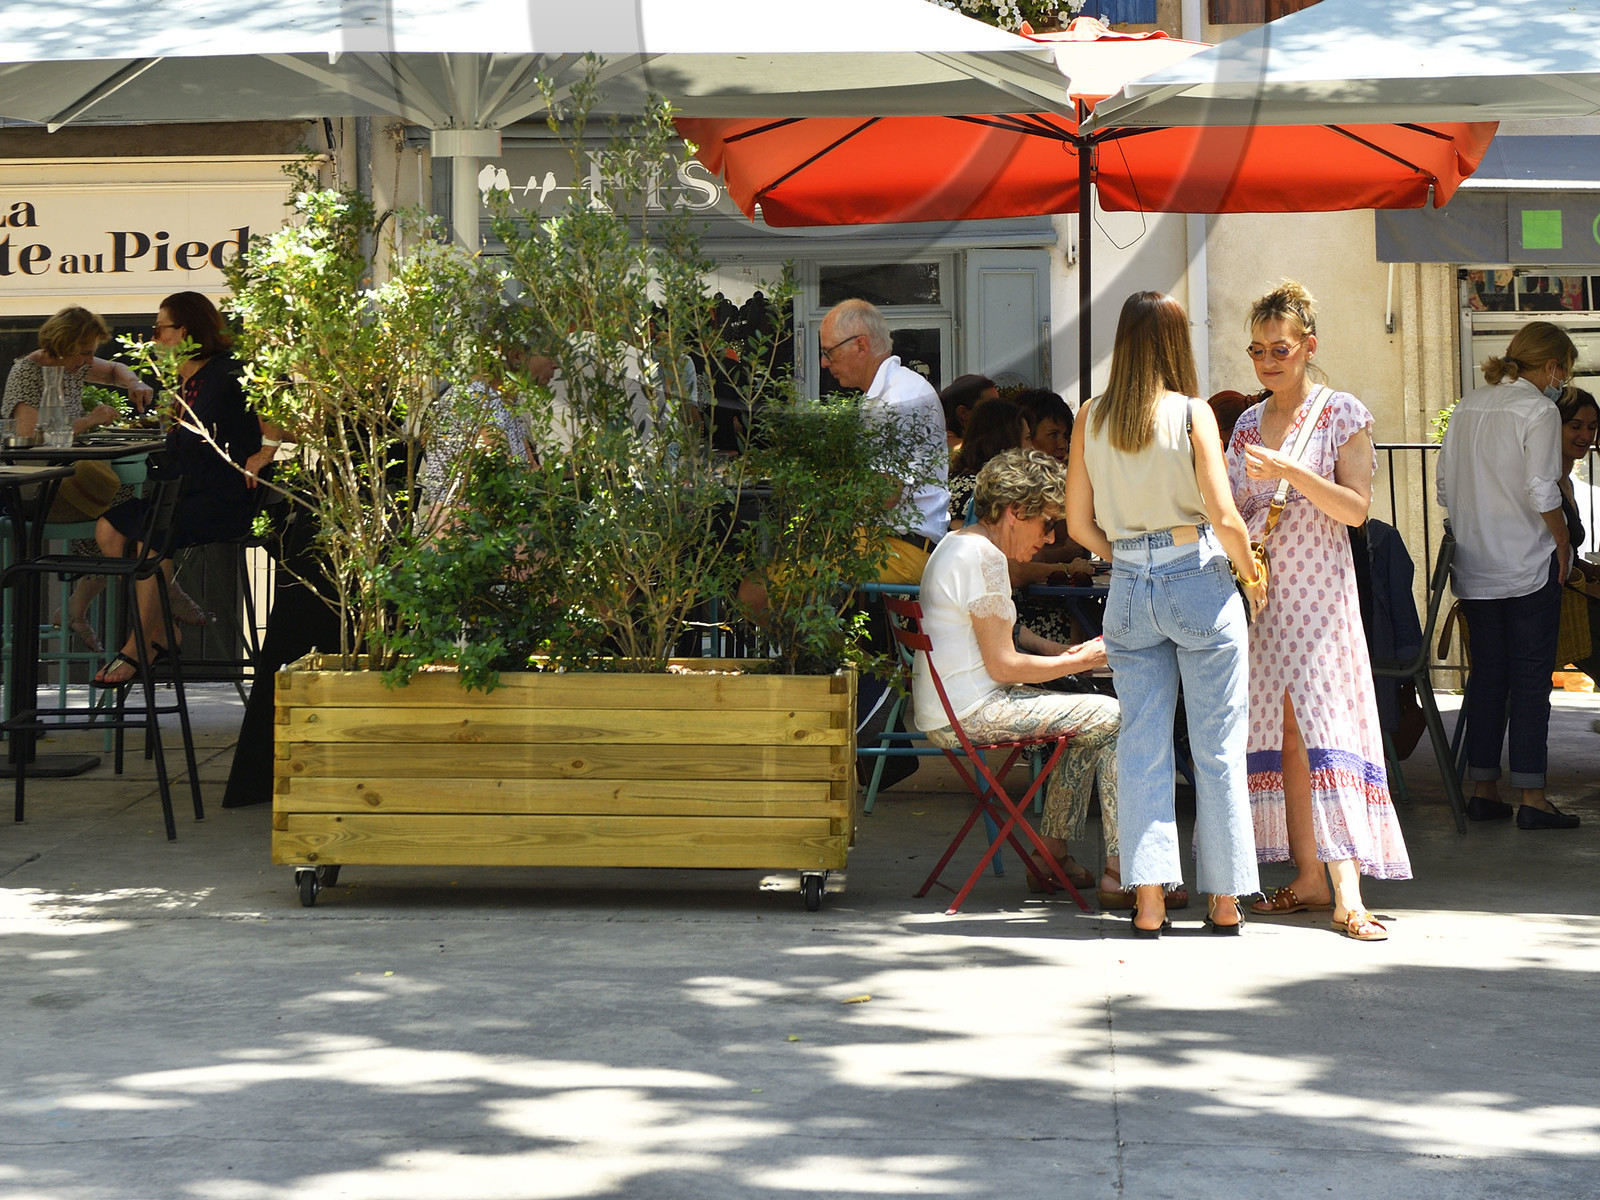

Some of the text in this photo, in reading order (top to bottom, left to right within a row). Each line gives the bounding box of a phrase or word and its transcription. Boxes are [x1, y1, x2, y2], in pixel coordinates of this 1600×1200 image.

[0, 201, 40, 227] a
[59, 253, 104, 275] au
[105, 226, 250, 273] Pied
